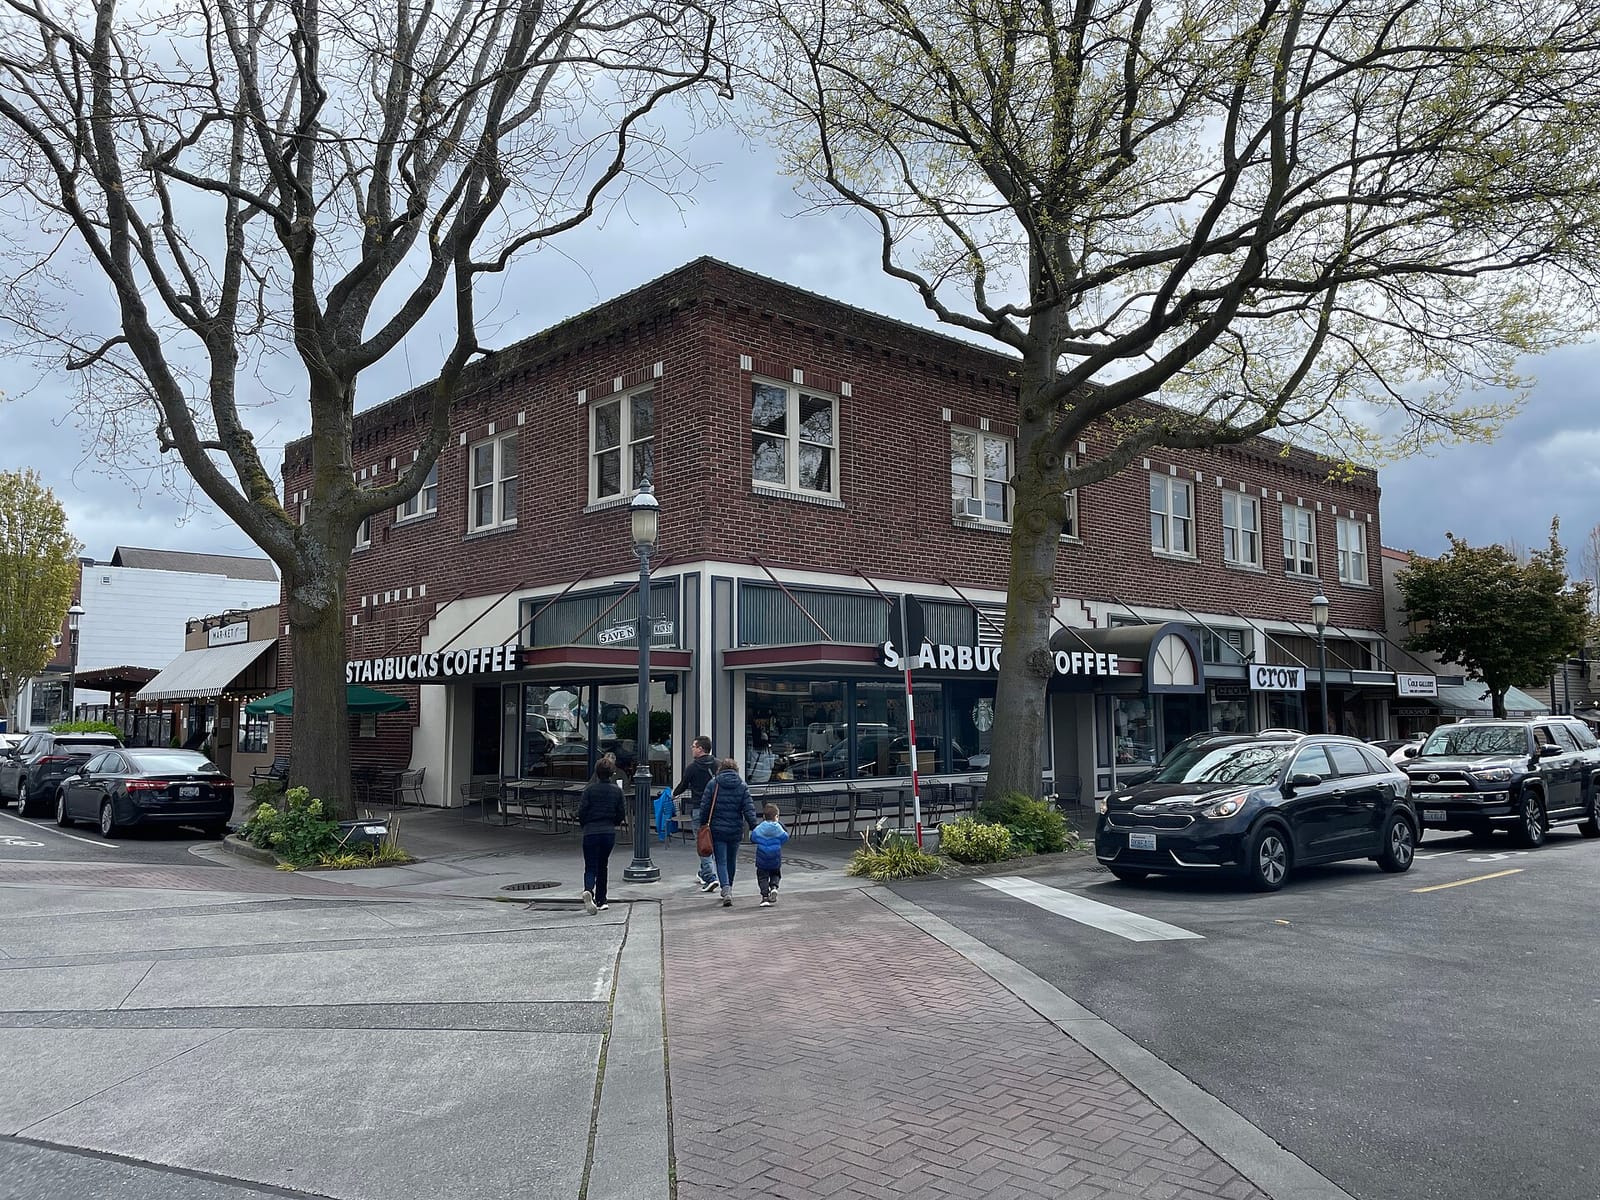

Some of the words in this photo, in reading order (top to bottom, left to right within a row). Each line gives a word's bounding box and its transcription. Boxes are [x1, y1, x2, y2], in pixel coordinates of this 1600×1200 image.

[627, 628, 634, 637] N
[346, 654, 439, 684] STARBUCKS
[442, 645, 517, 676] COFFEE
[1050, 650, 1120, 676] OFFEE
